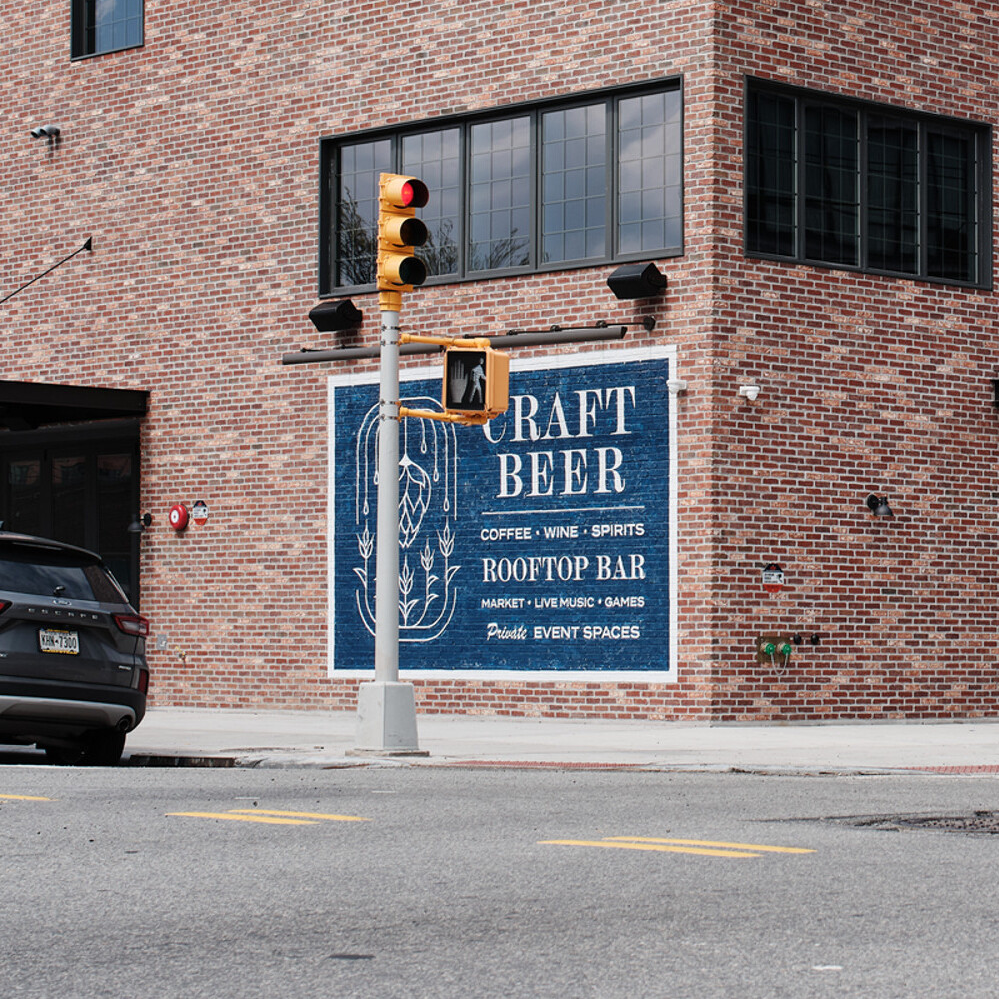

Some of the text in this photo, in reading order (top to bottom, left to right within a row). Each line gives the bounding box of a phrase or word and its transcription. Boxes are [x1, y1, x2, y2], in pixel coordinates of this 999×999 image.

[496, 446, 626, 499] BEER
[480, 523, 646, 541] COFFEE WINE SPIRITS
[482, 553, 647, 583] ROOFTOP BAR
[481, 596, 646, 609] MARKET LIVE MUSIC GAMES
[486, 622, 641, 641] Private EVENT SPACES
